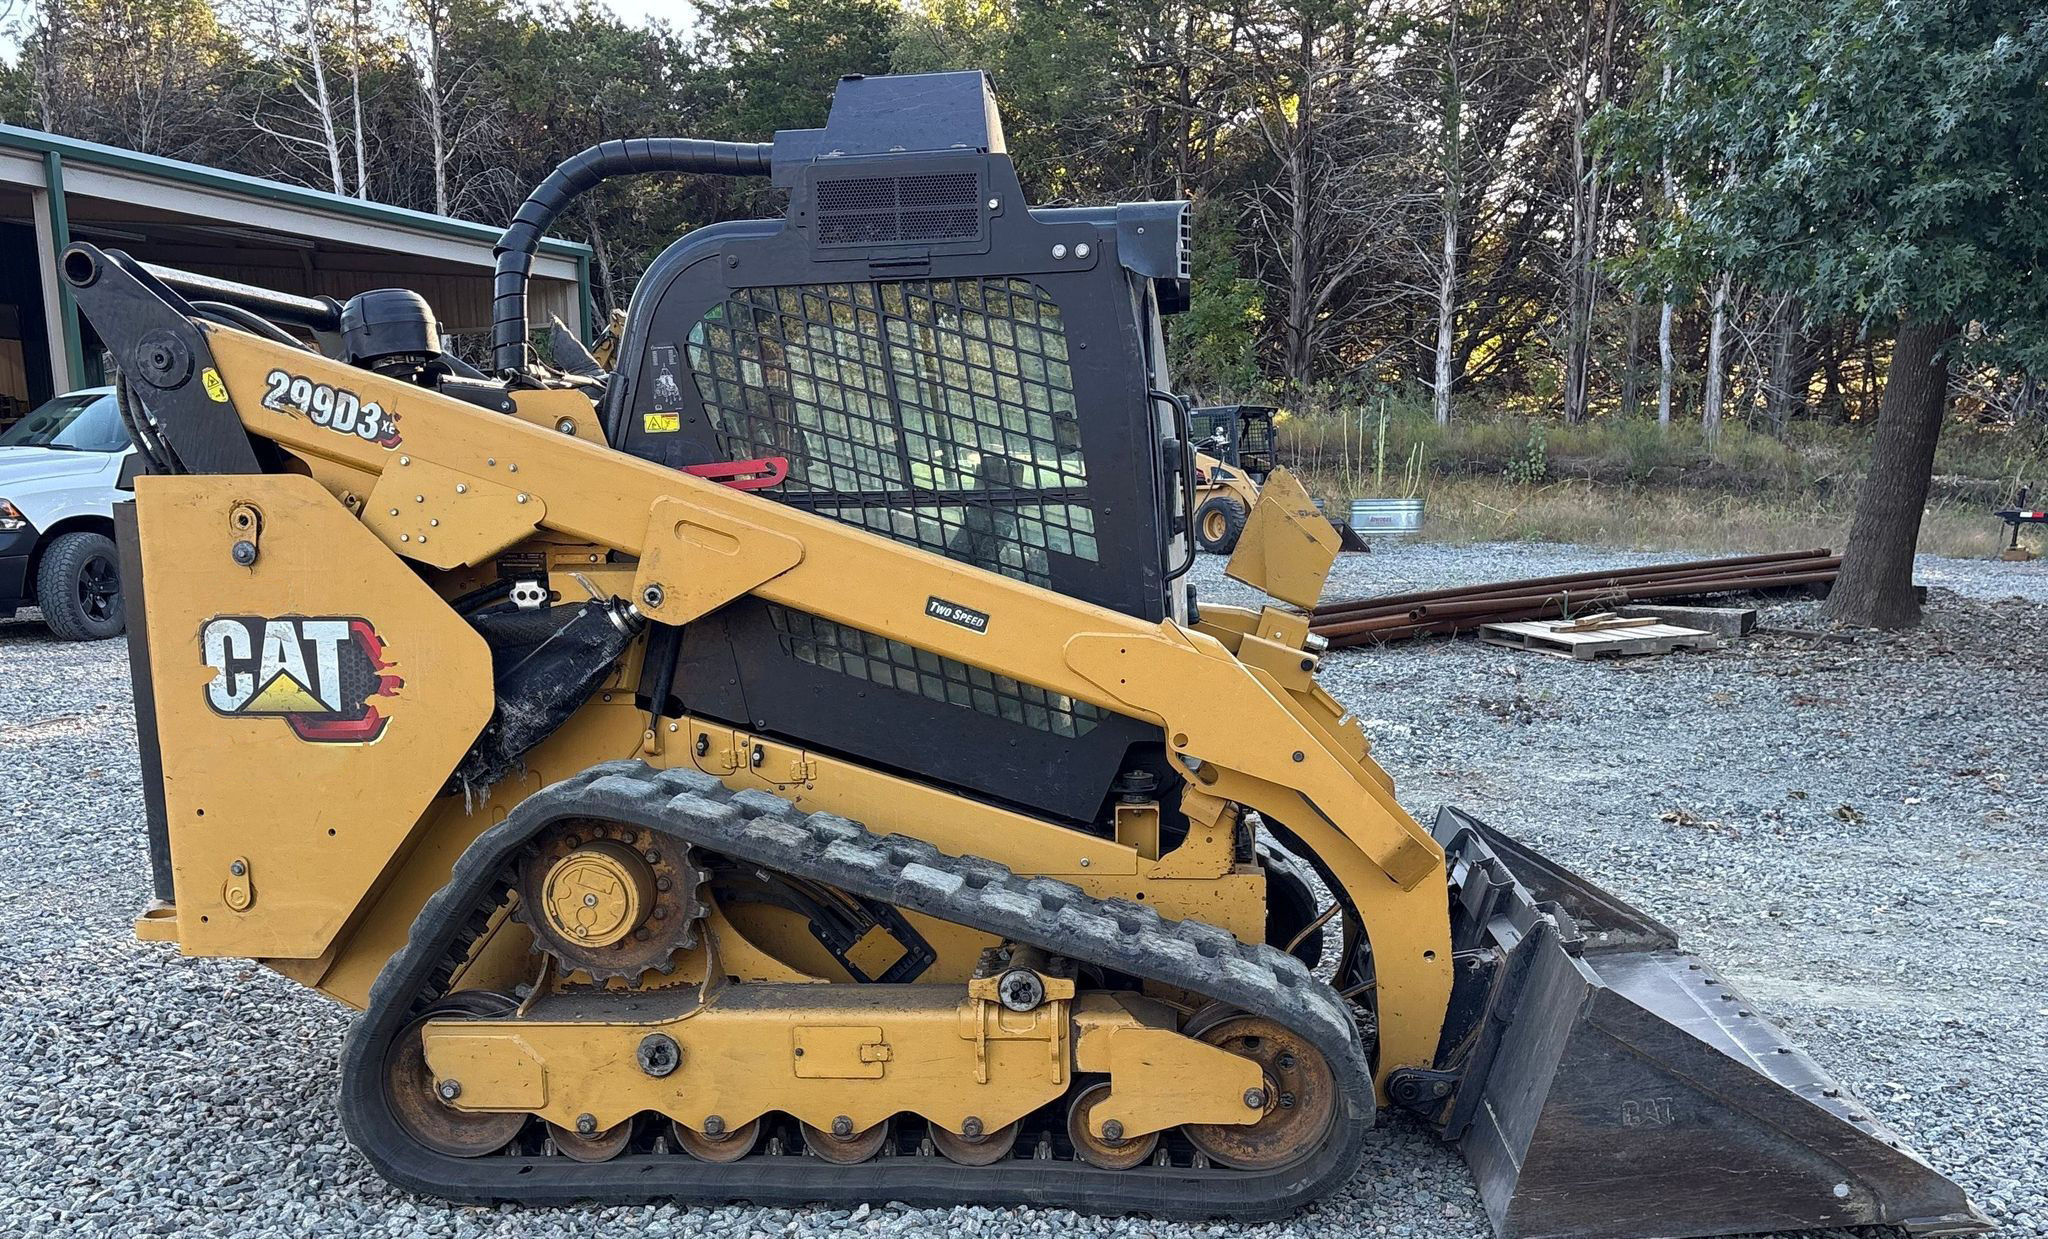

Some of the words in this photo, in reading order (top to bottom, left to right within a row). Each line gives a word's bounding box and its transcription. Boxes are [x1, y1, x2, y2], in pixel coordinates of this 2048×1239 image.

[263, 370, 382, 440] 299D3
[204, 619, 350, 713] CAT
[1621, 1096, 1673, 1127] CAT
